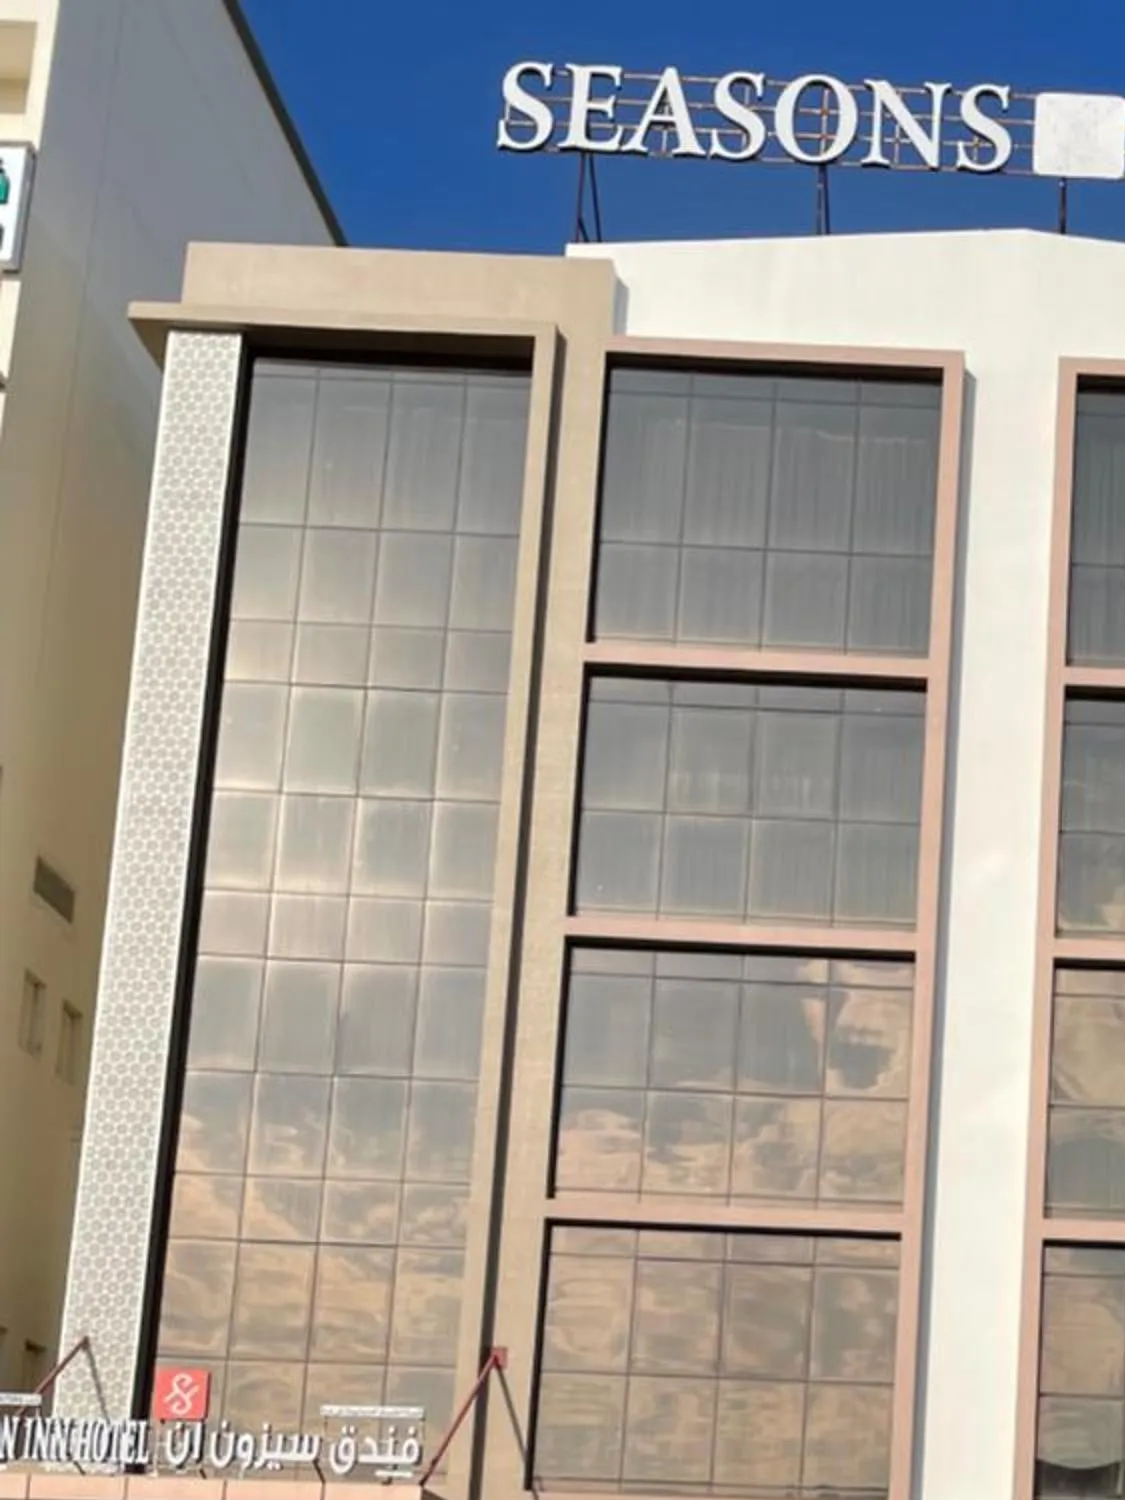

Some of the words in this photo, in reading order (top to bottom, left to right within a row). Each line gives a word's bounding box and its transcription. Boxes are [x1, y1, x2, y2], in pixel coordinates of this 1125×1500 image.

[497, 61, 1014, 173] SEASONS
[72, 1417, 150, 1464] HOTEL
[210, 1418, 321, 1471] سيزون
[329, 1424, 420, 1475] فندق
